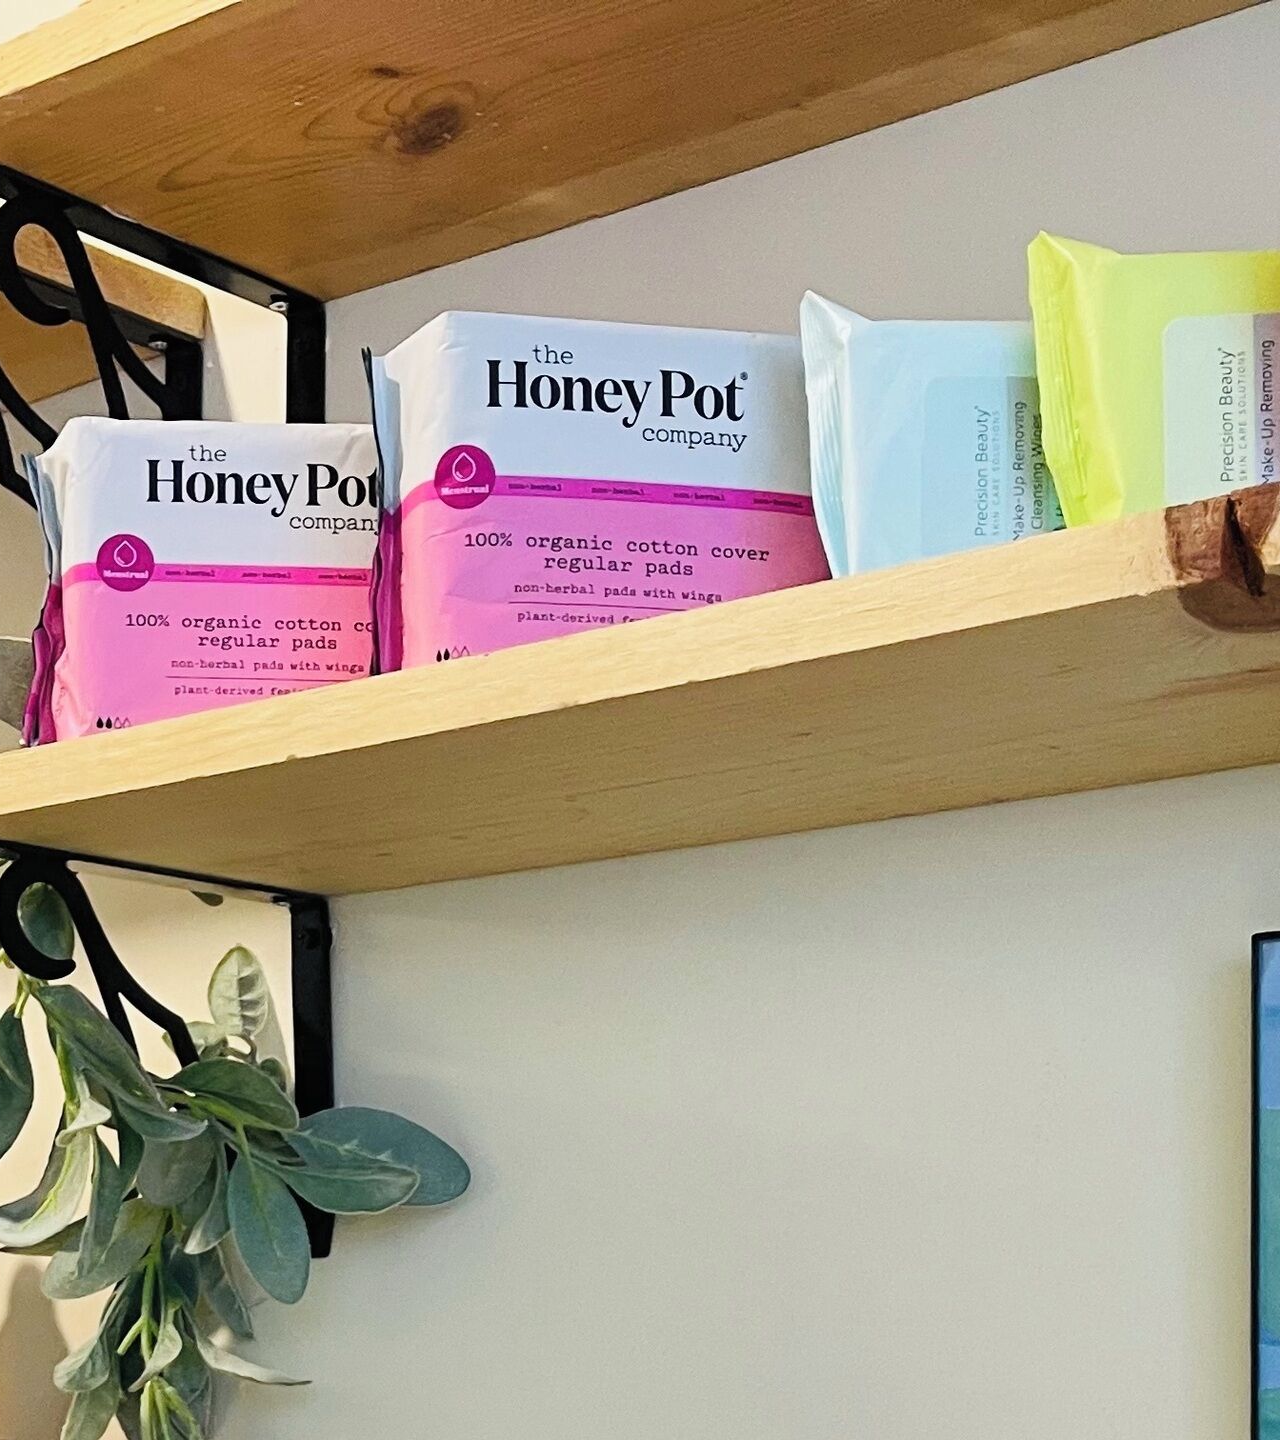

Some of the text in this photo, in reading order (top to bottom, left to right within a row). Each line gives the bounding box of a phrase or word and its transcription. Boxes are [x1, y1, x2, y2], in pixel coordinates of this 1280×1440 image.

[533, 344, 573, 365] the
[1237, 351, 1246, 414] SOLUTIONS
[1261, 340, 1275, 411] Removing
[486, 359, 652, 428] Honey
[1219, 349, 1236, 482] Precision Beauty
[642, 427, 748, 453] company
[1013, 401, 1026, 471] Removing
[189, 445, 227, 462] the
[975, 407, 991, 536] Precision Beauty
[146, 459, 299, 517] Honey
[1031, 463, 1045, 529] Cleansing
[289, 516, 379, 536] compan
[464, 532, 770, 562] 100% organic cotton cover
[544, 555, 694, 578] regular pads
[513, 582, 722, 603] non-herbal pads with wings
[125, 613, 170, 627] 100%
[181, 615, 262, 633] organic
[274, 618, 342, 632] cotton
[517, 611, 614, 625] plant-derived
[198, 634, 337, 651] regular pads
[171, 659, 365, 674] non-herbal pads with wings
[174, 685, 263, 696] plant-derived
